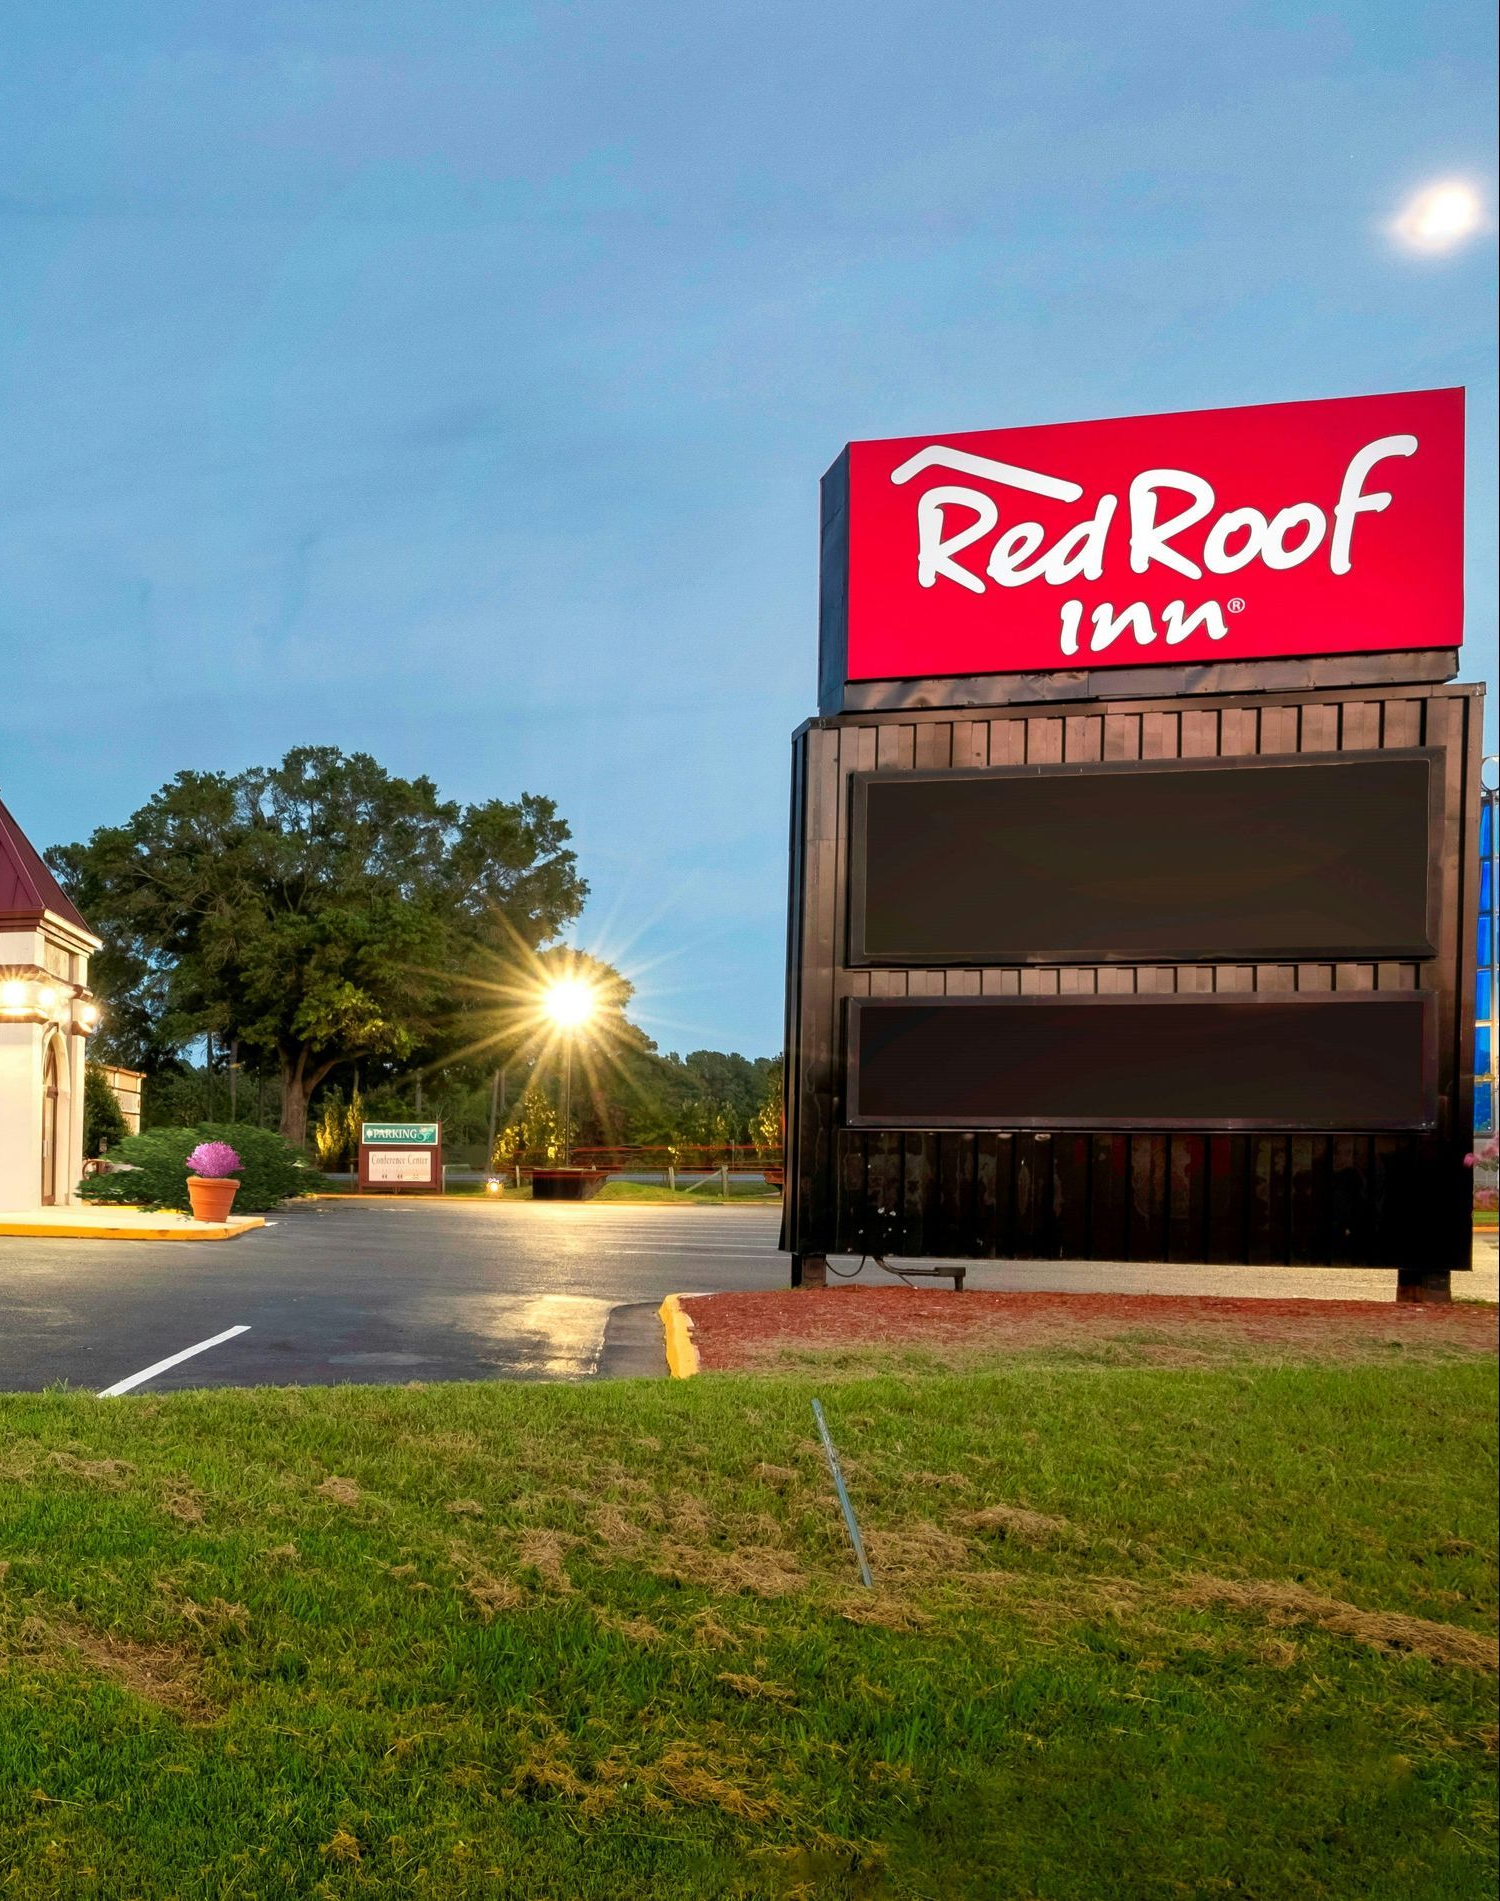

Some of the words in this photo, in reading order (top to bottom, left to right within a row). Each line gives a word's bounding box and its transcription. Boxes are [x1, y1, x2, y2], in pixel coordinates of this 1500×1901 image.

[917, 485, 1118, 595] Red
[1129, 433, 1419, 581] Roof
[372, 1128, 418, 1138] PARKING
[371, 1154, 406, 1165] Conference
[407, 1154, 428, 1165] Center
